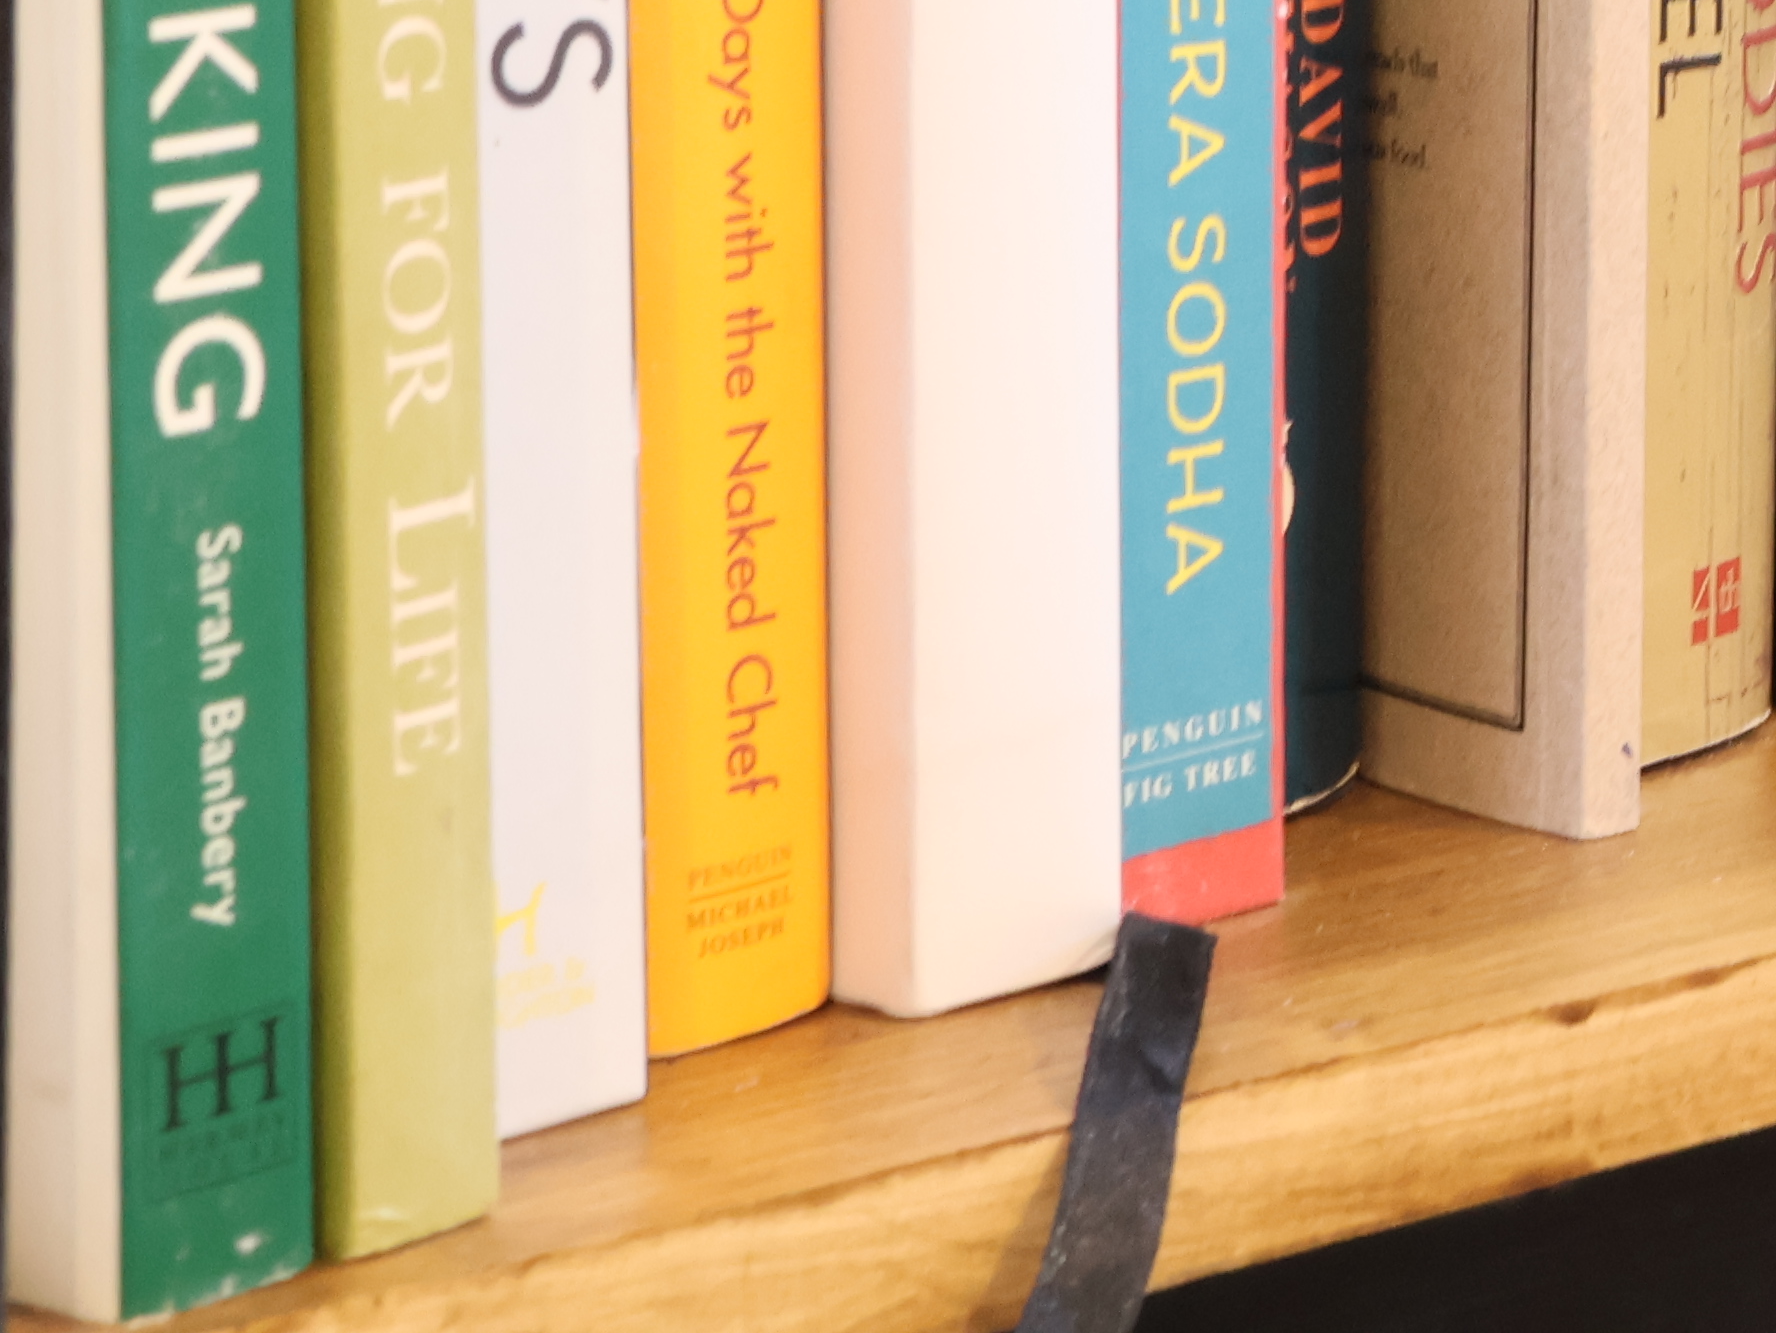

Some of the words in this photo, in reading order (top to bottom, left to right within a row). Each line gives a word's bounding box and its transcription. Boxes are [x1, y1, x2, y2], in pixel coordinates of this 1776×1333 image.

[723, 152, 774, 283] with
[379, 170, 456, 429] FOR
[725, 303, 775, 400] the
[1166, 214, 1226, 596] SODHA
[724, 420, 777, 632] Naked
[197, 524, 244, 681] Sarah
[387, 475, 477, 778] LIFE
[725, 653, 781, 797] Chef
[1121, 699, 1264, 759] PENGUIN
[1122, 770, 1173, 808] FIG
[1184, 752, 1258, 794] TREE
[191, 696, 247, 927] Banbery
[688, 842, 793, 891] PENGUIN
[686, 885, 793, 932] MICHAEL
[698, 916, 786, 959] JOSEPH
